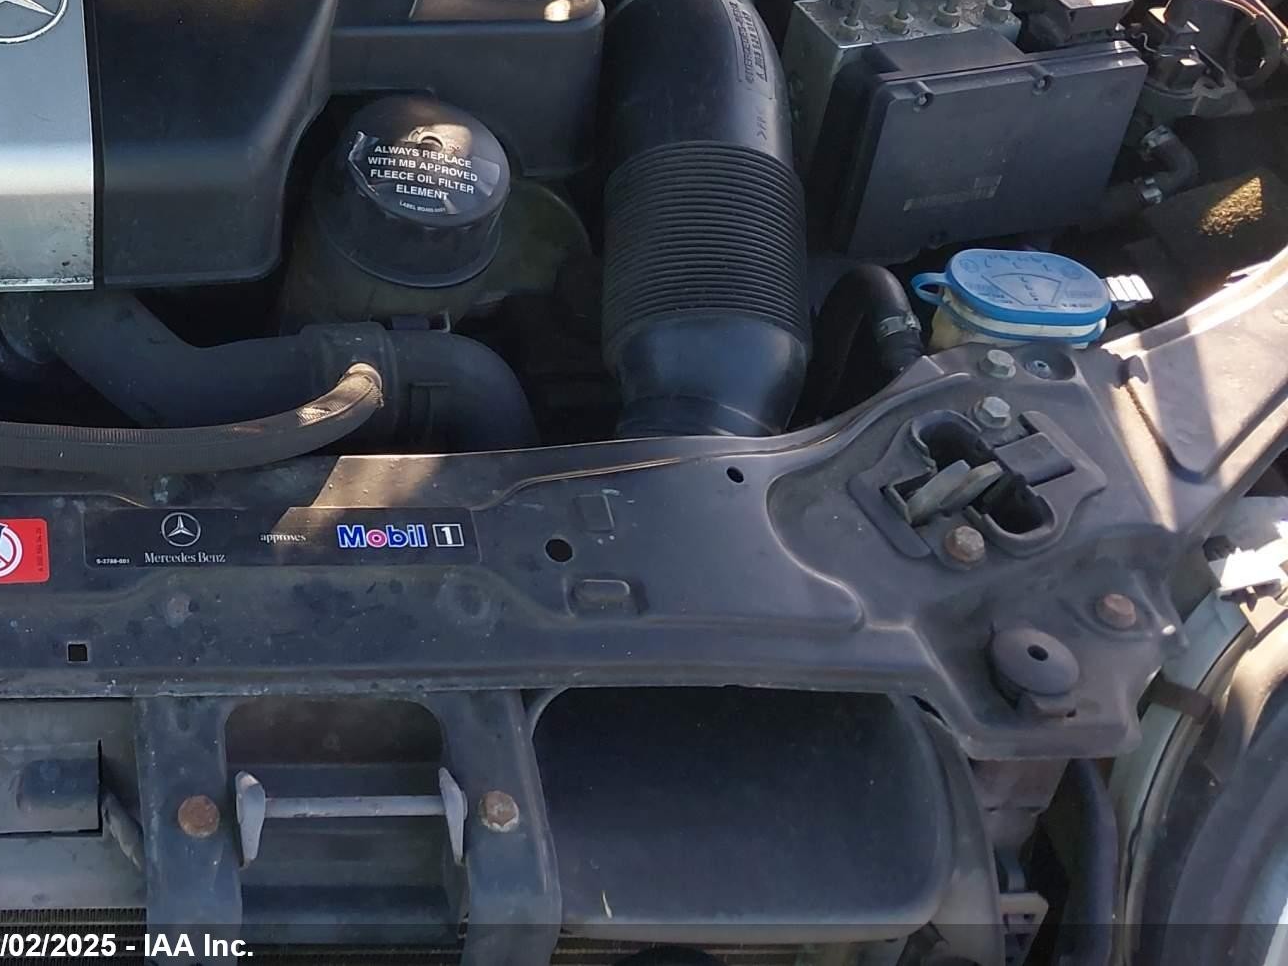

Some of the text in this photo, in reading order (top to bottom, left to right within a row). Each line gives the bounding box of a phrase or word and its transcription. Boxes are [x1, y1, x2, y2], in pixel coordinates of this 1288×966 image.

[368, 156, 478, 182] WITH MB APPROVED
[374, 145, 473, 169] ALWAYS REPLACE
[370, 169, 475, 194] FLEECE OIL FILTER
[396, 184, 450, 201] ELEMENT
[260, 533, 307, 543] approves
[336, 524, 428, 548] Mobil
[144, 551, 196, 563] Mercedes
[198, 551, 226, 563] Benz
